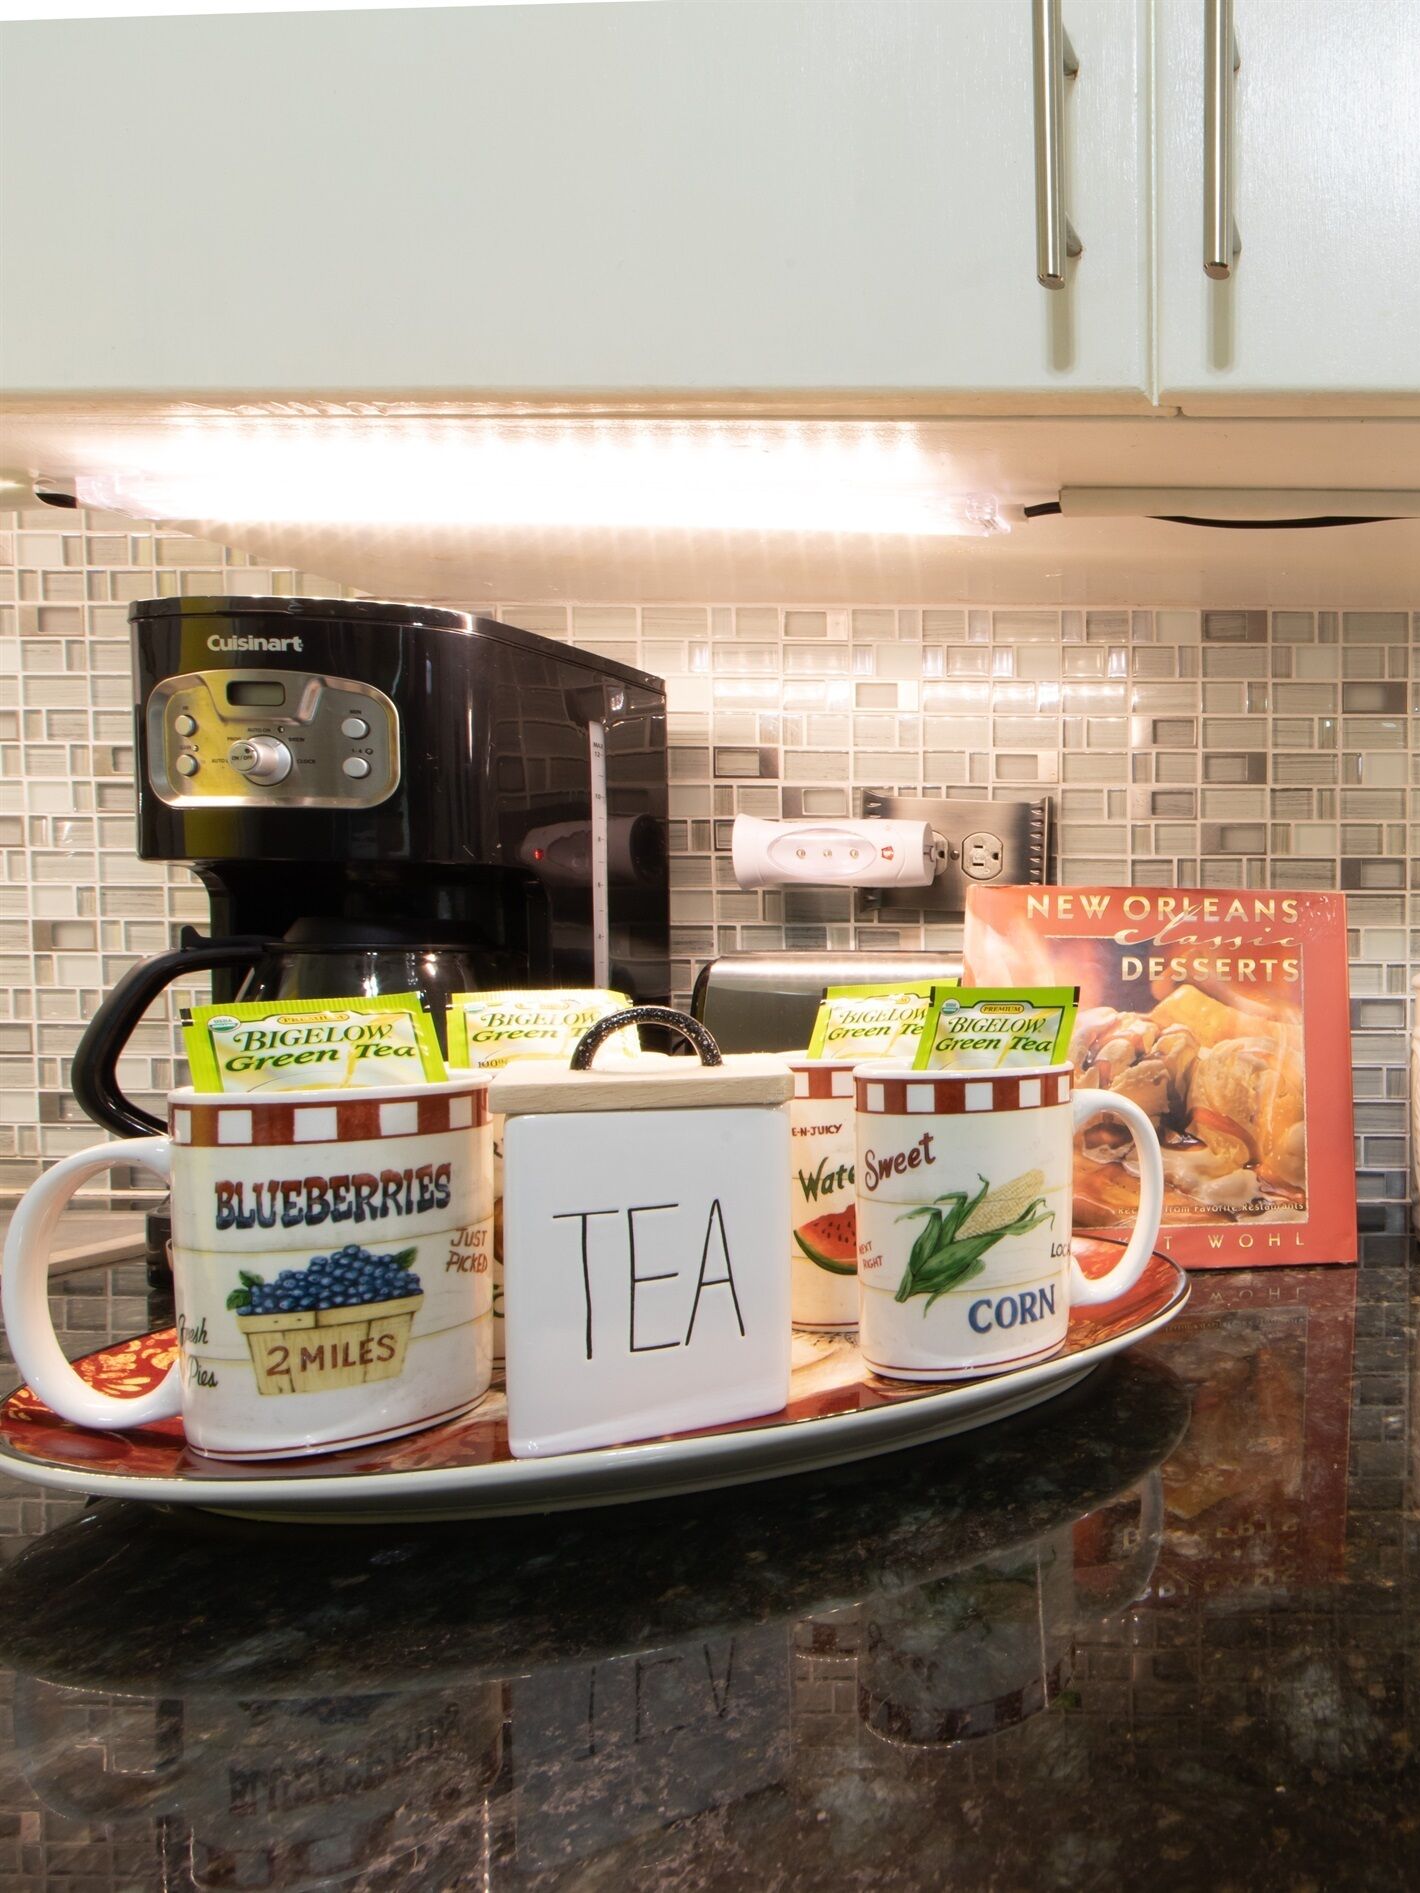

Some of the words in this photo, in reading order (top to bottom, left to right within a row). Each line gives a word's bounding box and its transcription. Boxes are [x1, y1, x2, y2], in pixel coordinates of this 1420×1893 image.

[206, 634, 302, 652] Cuisinart
[1027, 894, 1111, 920] NEW
[1123, 896, 1299, 923] ORLEANS
[1121, 956, 1299, 982] DESSERTS
[472, 1028, 558, 1042] Green
[828, 1026, 891, 1041] Green
[900, 1024, 924, 1035] Te
[949, 1016, 1046, 1033] BIGELOW
[233, 1024, 393, 1052] BIGELOW
[935, 1037, 1001, 1052] Green
[1009, 1036, 1053, 1052] Tea
[225, 1047, 338, 1072] Green
[354, 1043, 415, 1060] Tea
[791, 1123, 843, 1137] E-N-JUICY
[864, 1131, 936, 1192] Sweet
[798, 1156, 855, 1203] Wate
[215, 1162, 452, 1230] BLUEBERRIES
[451, 1228, 488, 1248] JUST
[1208, 1232, 1304, 1248] WOHL
[445, 1250, 488, 1273] PICKED
[552, 1198, 745, 1360] TEA
[968, 1284, 1056, 1334] CORN
[266, 1345, 291, 1376] 2
[299, 1334, 397, 1373] MILES
